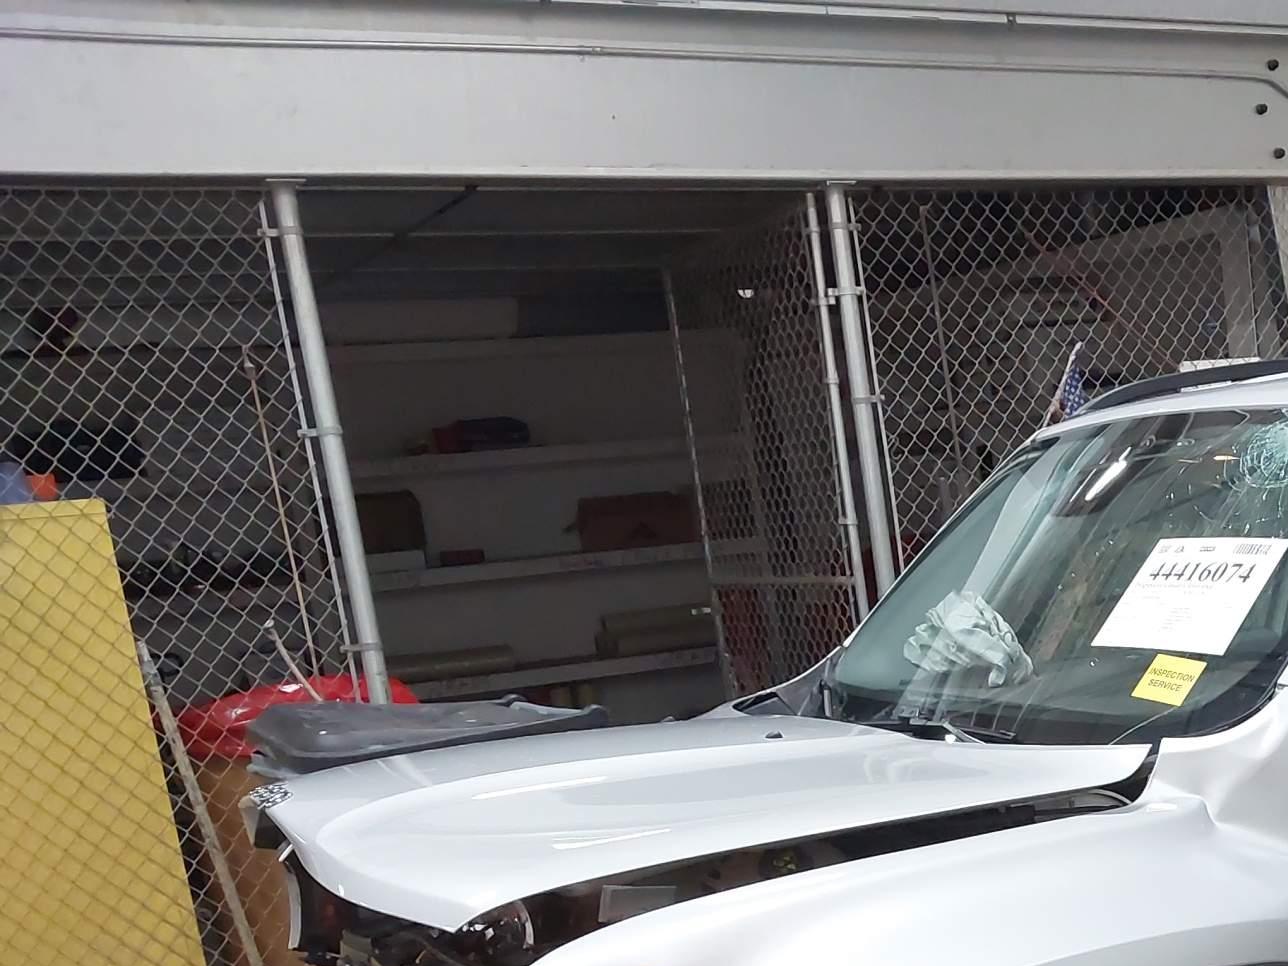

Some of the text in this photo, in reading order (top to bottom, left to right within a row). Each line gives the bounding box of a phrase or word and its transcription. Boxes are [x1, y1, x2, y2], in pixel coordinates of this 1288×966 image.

[1149, 561, 1256, 584] 44416074
[1149, 667, 1194, 683] INSPECTION
[1147, 678, 1183, 692] SERVICE
